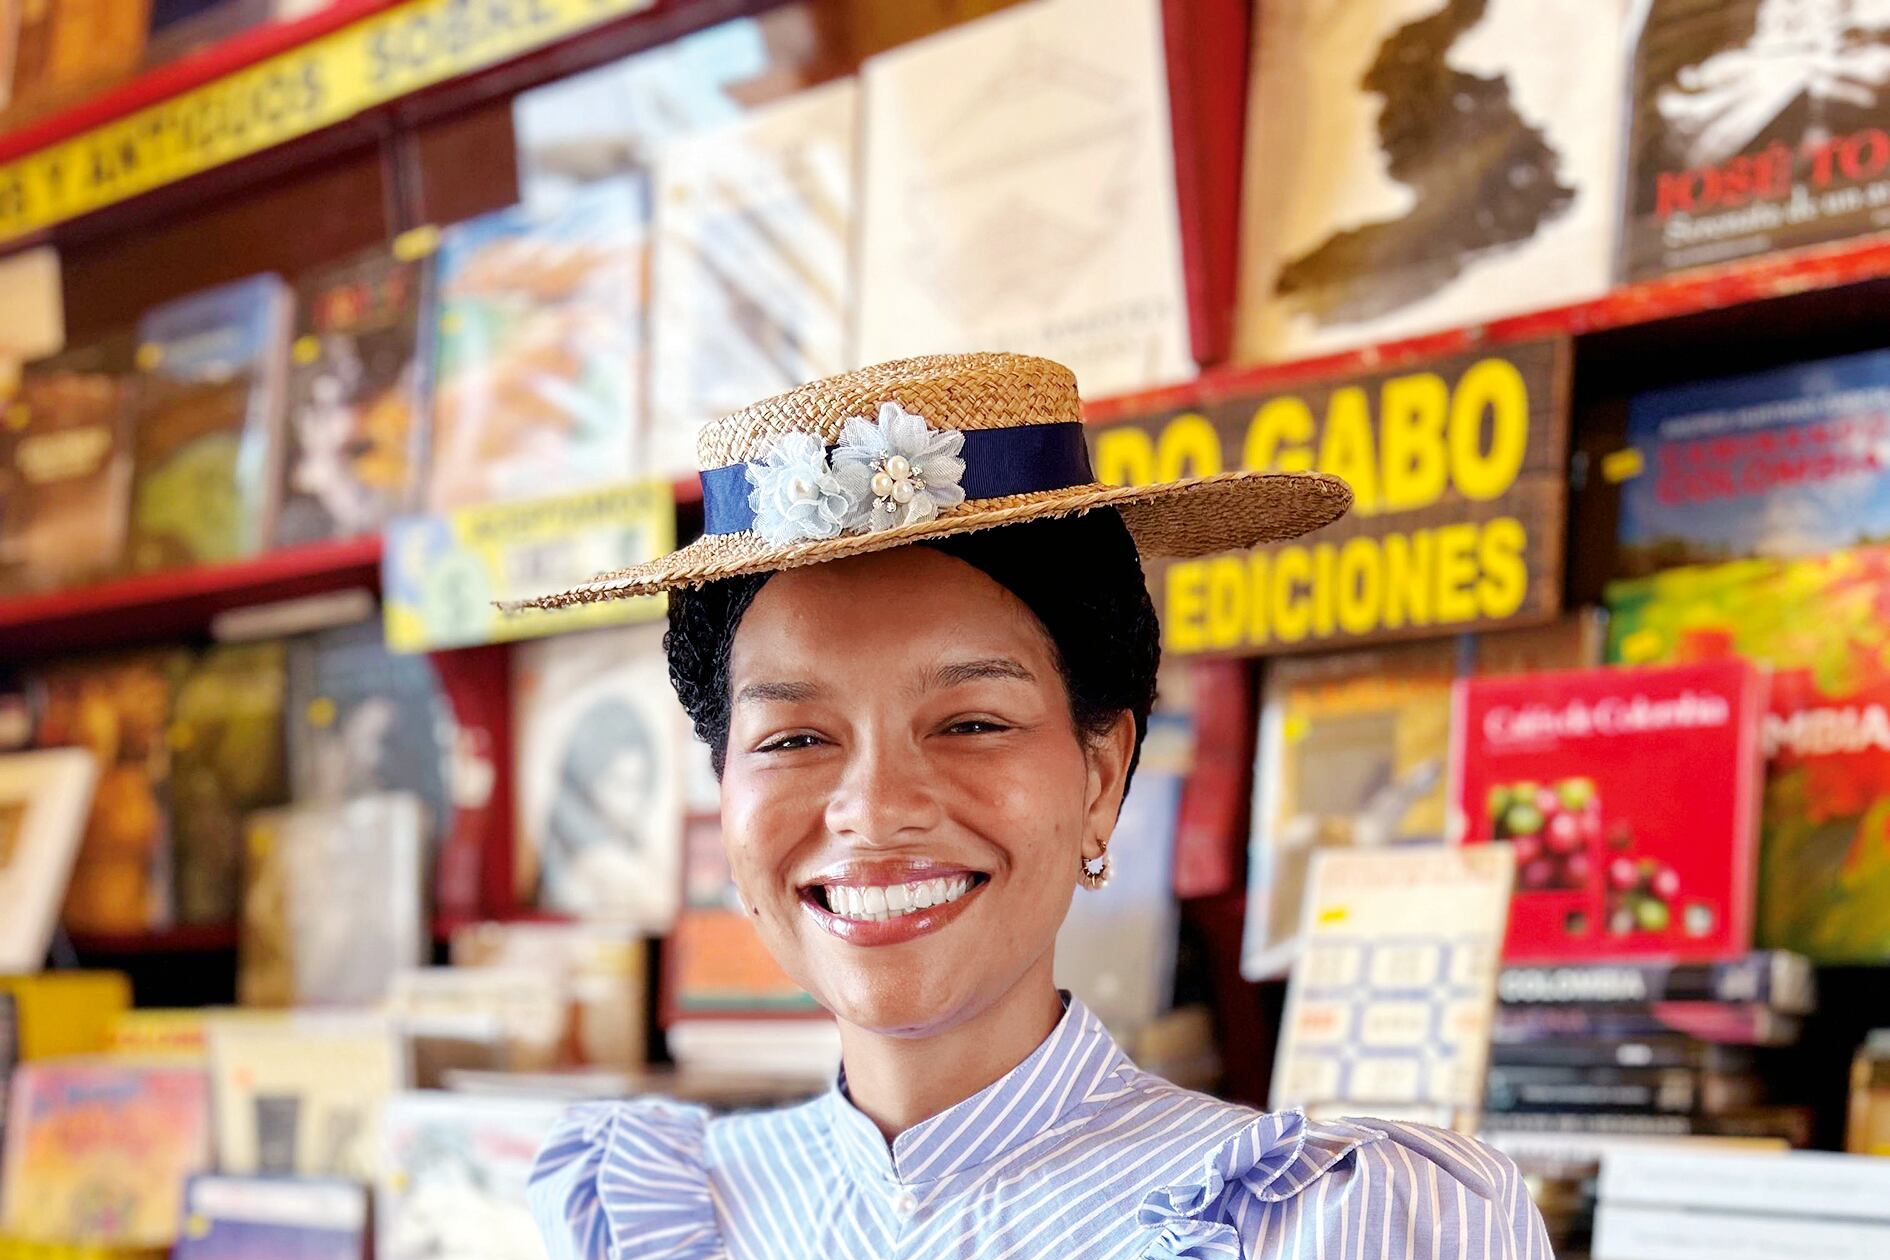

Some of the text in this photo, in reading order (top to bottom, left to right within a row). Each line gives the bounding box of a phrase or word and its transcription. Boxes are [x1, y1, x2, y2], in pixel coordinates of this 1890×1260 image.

[1243, 357, 1530, 518] GABO
[1165, 516, 1529, 656] EDICIONES
[1760, 703, 1890, 757] MBIA
[1499, 967, 1646, 1001] COLOMBIA
